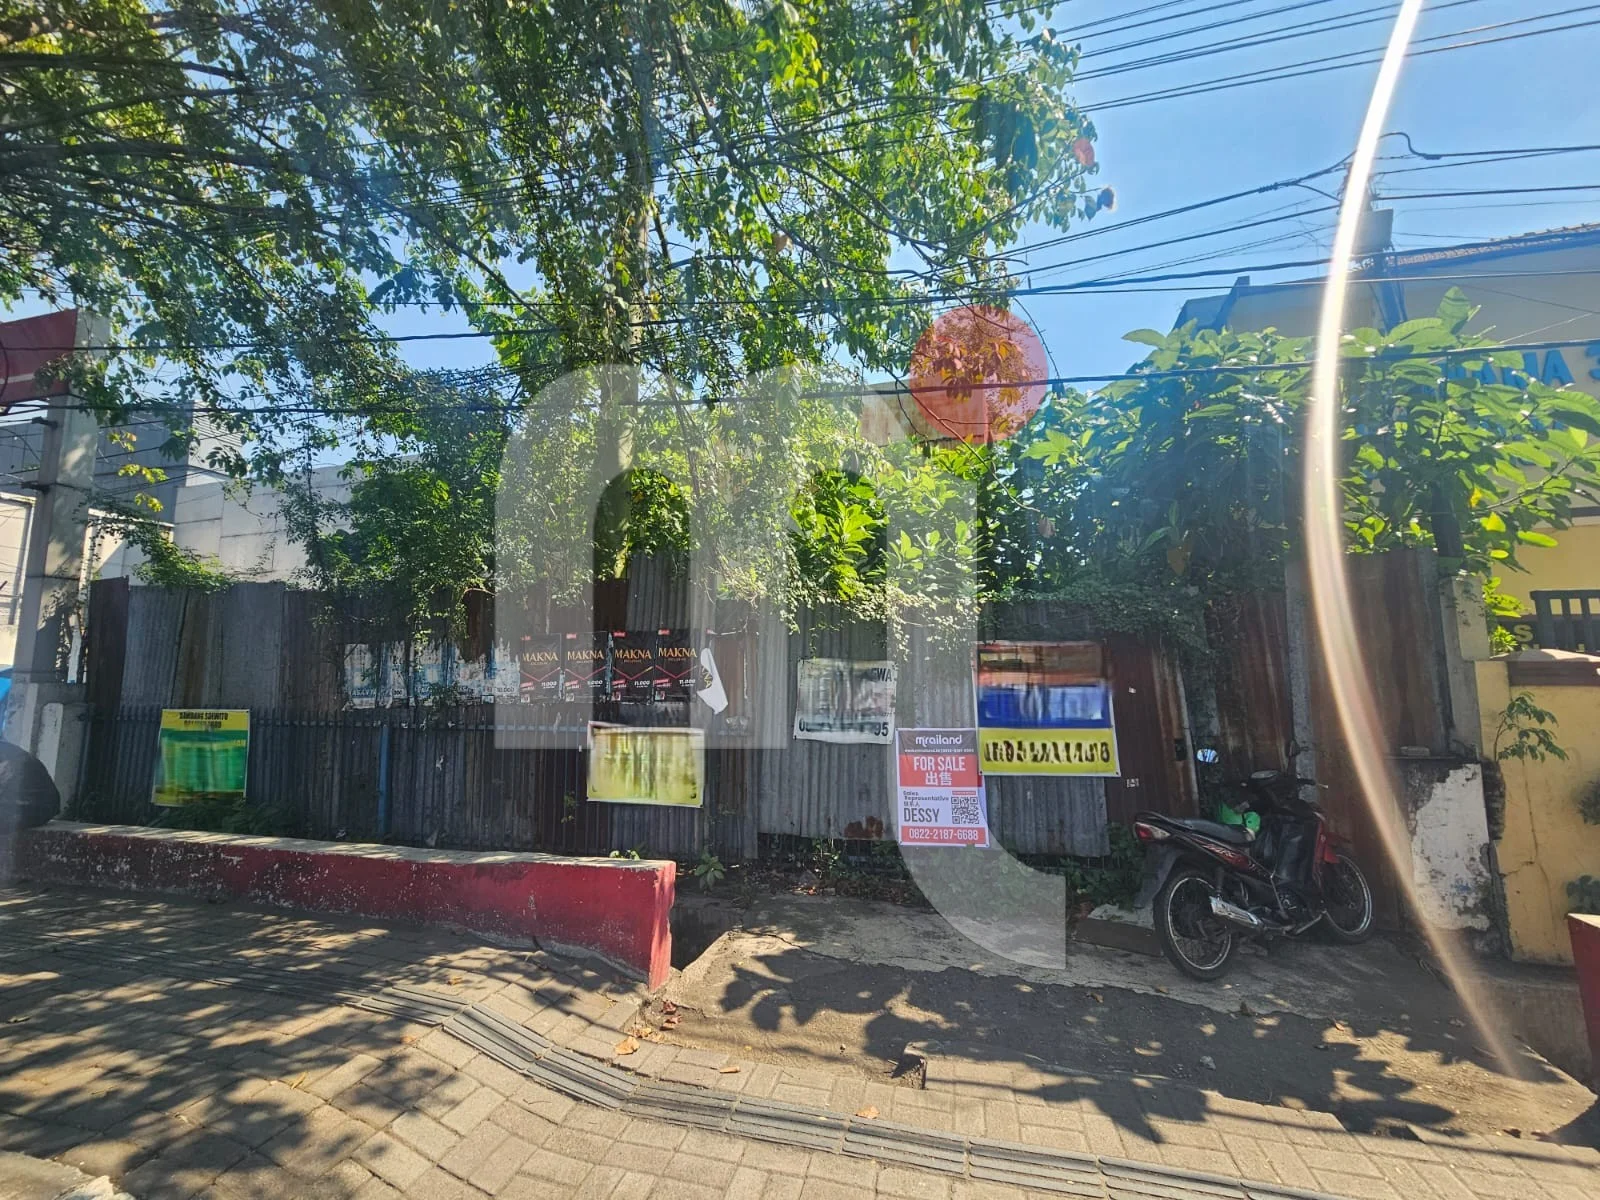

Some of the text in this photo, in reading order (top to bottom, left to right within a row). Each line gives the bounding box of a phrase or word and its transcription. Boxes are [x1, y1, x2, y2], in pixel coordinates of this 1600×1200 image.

[522, 651, 559, 662] MAKNA
[567, 649, 605, 661] MAKNA
[614, 648, 652, 660] MAKNA
[658, 647, 697, 658] MAKNA
[913, 756, 966, 771] FOR SALE
[925, 771, 952, 786] 出售
[903, 807, 940, 823] DESSY
[908, 828, 979, 841] 0822-2187-6688
